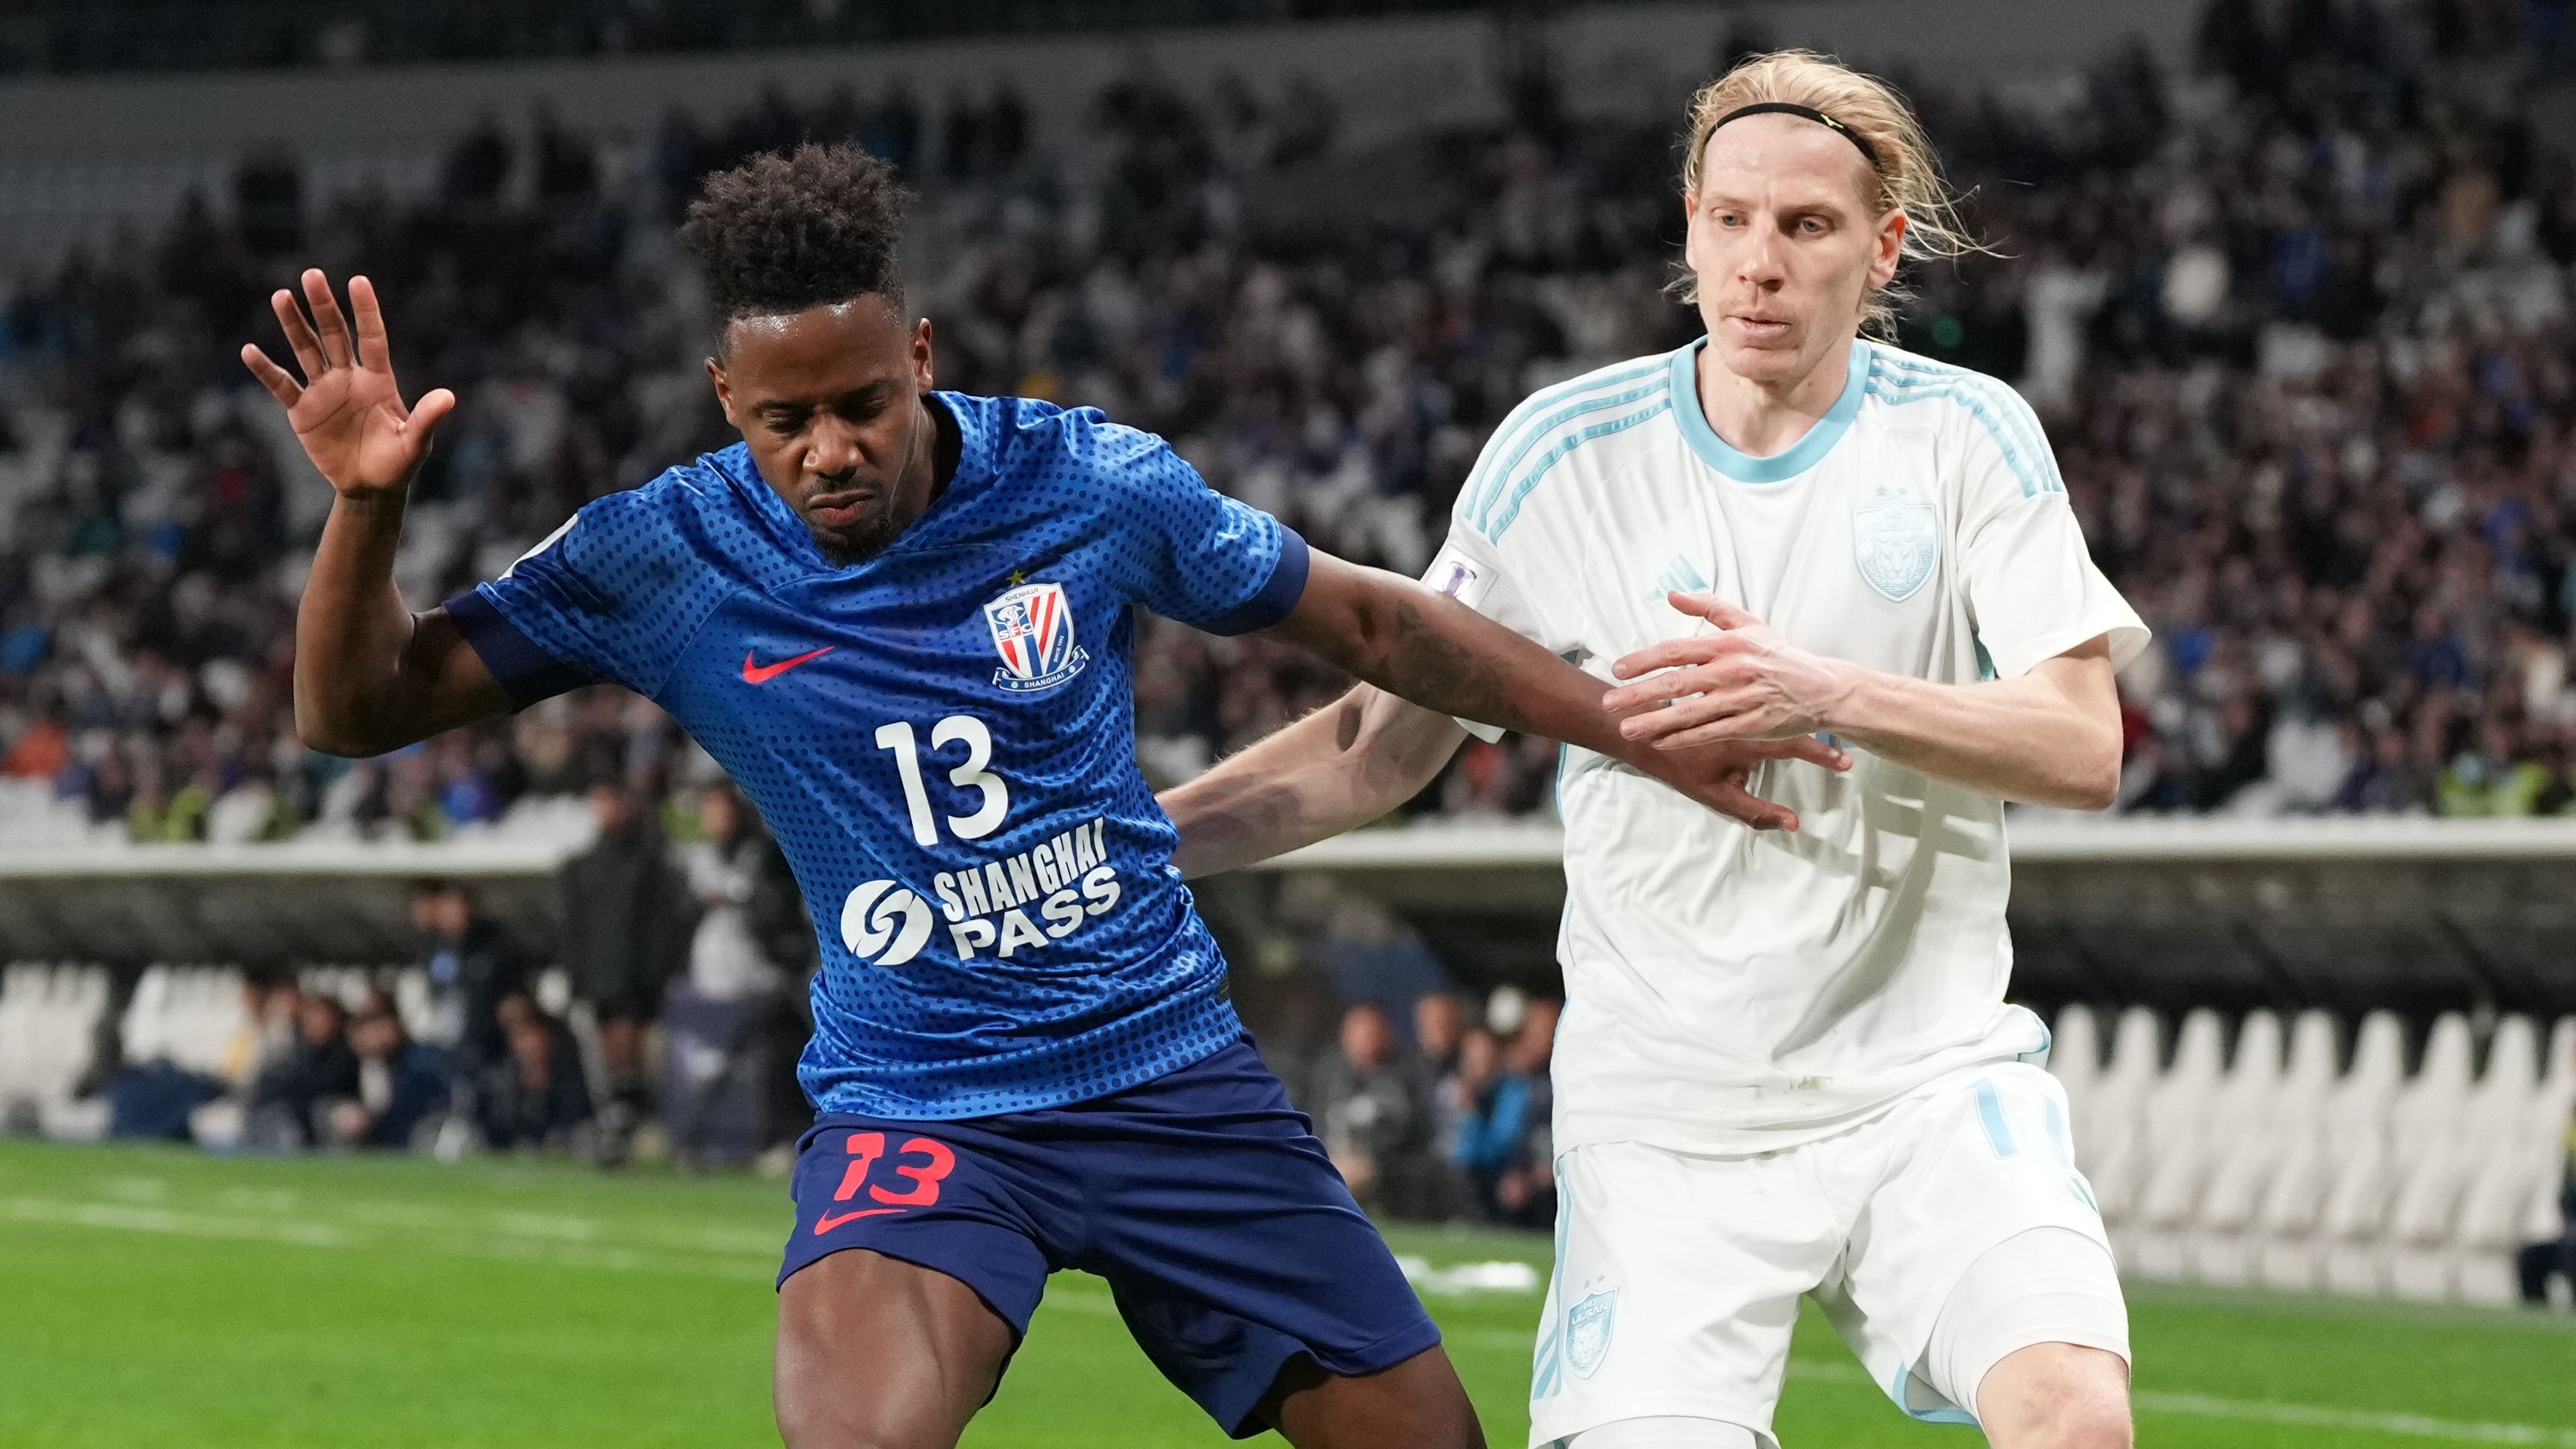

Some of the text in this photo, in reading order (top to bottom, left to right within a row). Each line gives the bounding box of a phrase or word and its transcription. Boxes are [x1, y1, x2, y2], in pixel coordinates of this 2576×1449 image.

[999, 622, 1033, 640] SFC
[1006, 587, 1039, 602] SHENHUA
[1024, 673, 1065, 688] SHANGHAI
[875, 715, 1009, 847] 13
[934, 817, 1109, 922] SHANGHAI
[949, 866, 1121, 961] PASS
[833, 1132, 955, 1207] 13
